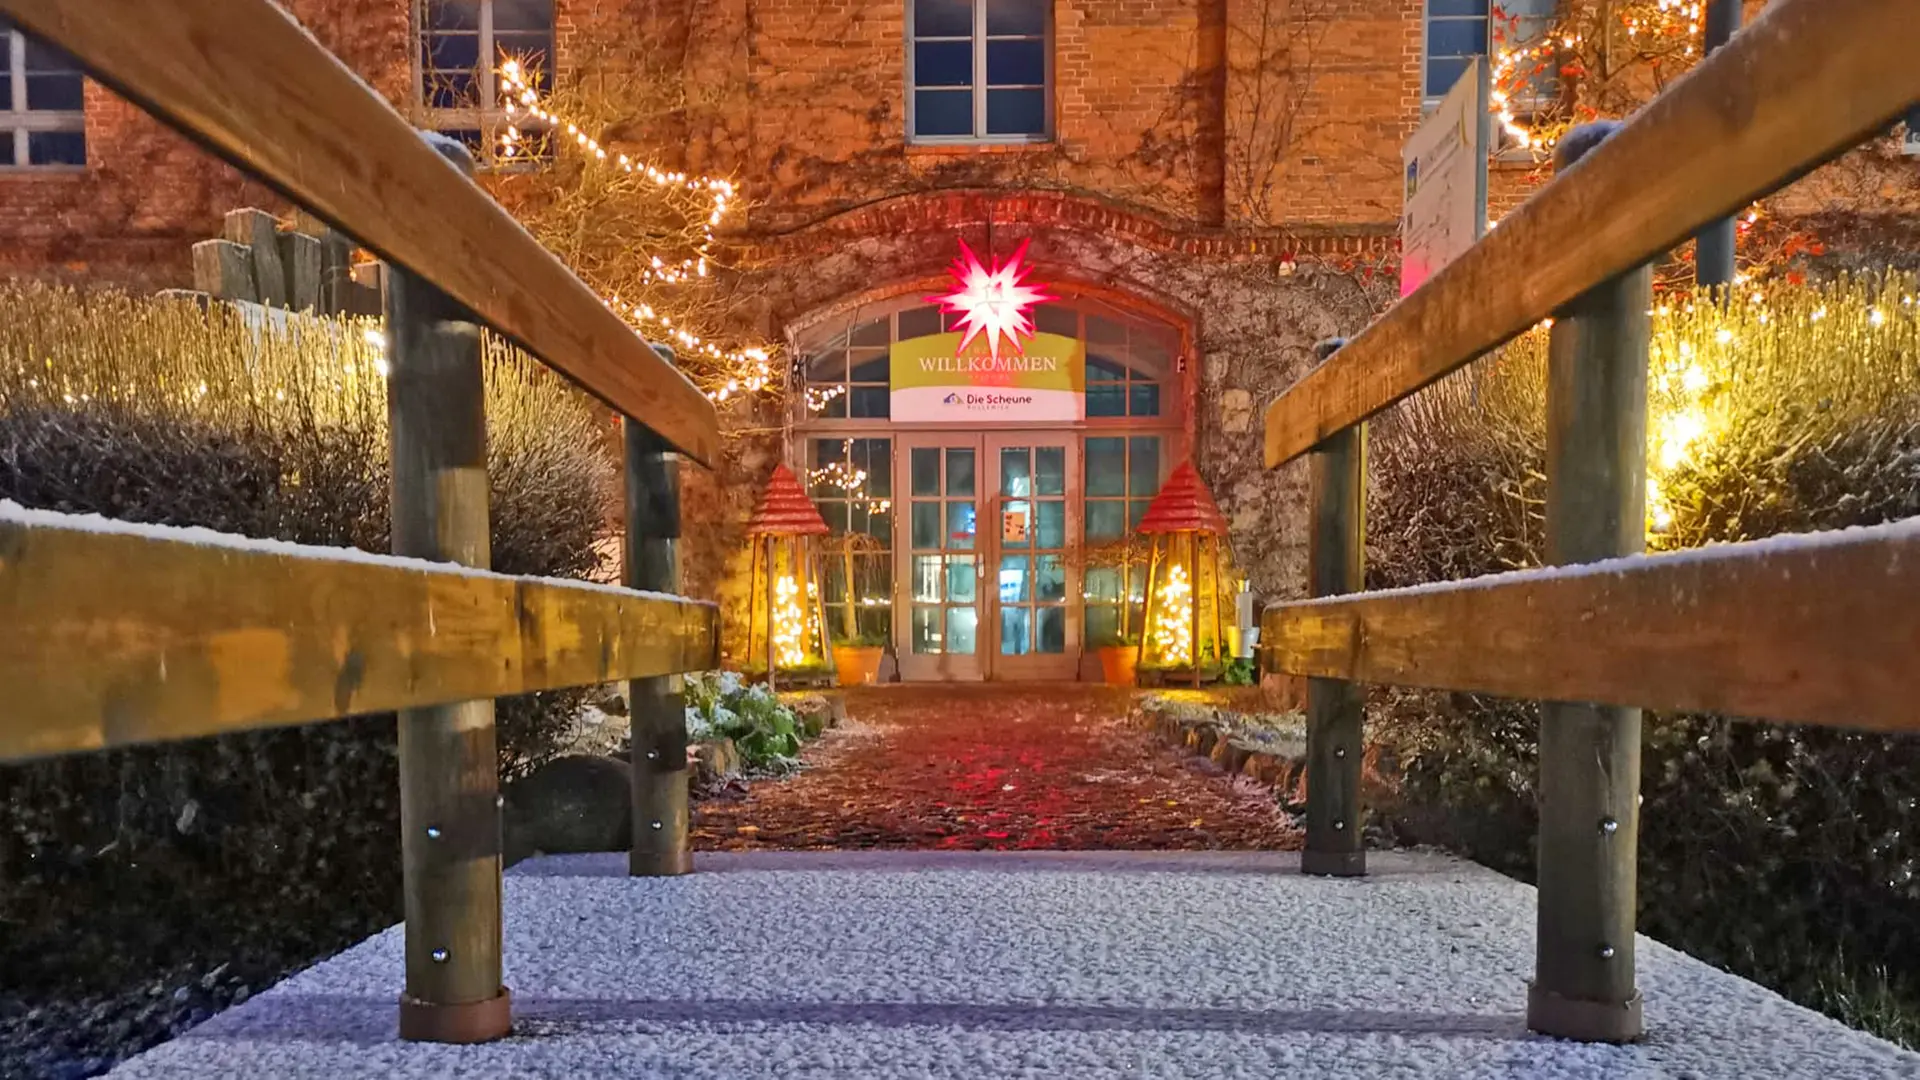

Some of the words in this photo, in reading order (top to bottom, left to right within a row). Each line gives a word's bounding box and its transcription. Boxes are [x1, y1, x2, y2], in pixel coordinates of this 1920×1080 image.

[919, 356, 1057, 372] WILLKOMMEN
[967, 394, 984, 404] Die
[986, 394, 1032, 404] Scheune
